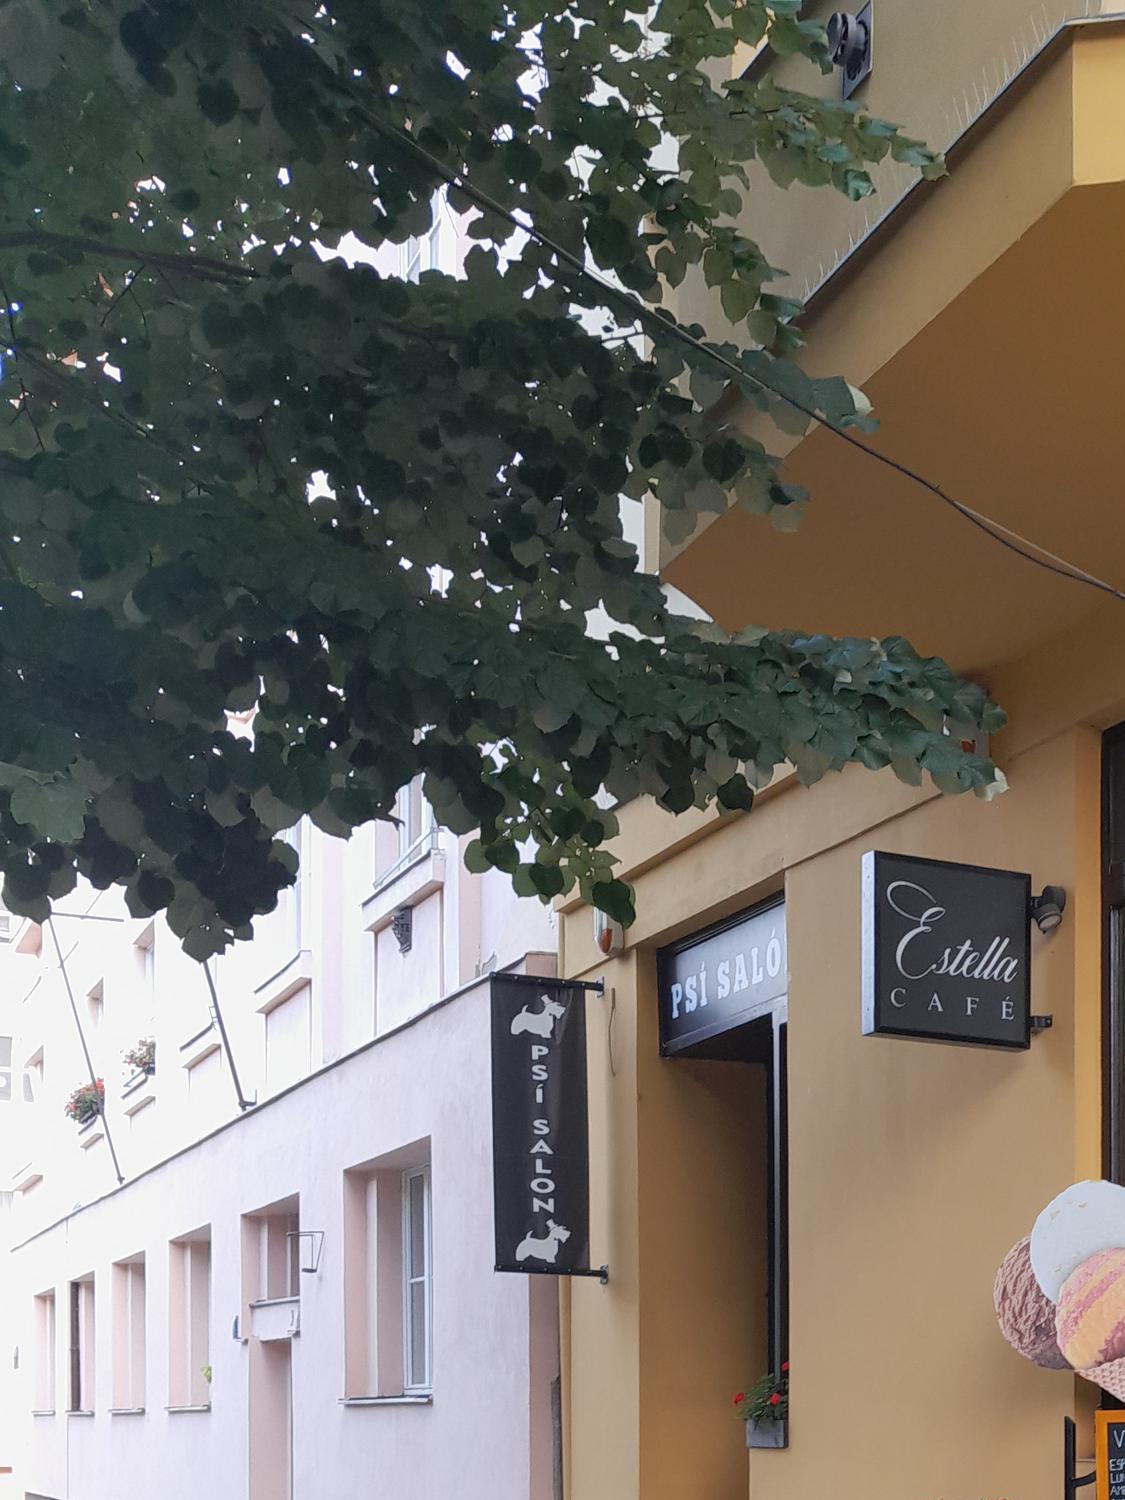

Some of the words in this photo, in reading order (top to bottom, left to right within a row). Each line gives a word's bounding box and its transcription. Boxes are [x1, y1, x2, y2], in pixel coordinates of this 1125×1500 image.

[671, 961, 708, 1019] PSÍ
[717, 928, 787, 1000] SALÓ
[886, 881, 1018, 983] Estella
[890, 987, 1015, 1021] CAFÉ
[531, 1044, 550, 1104] PSÍ
[529, 1119, 556, 1213] SALON
